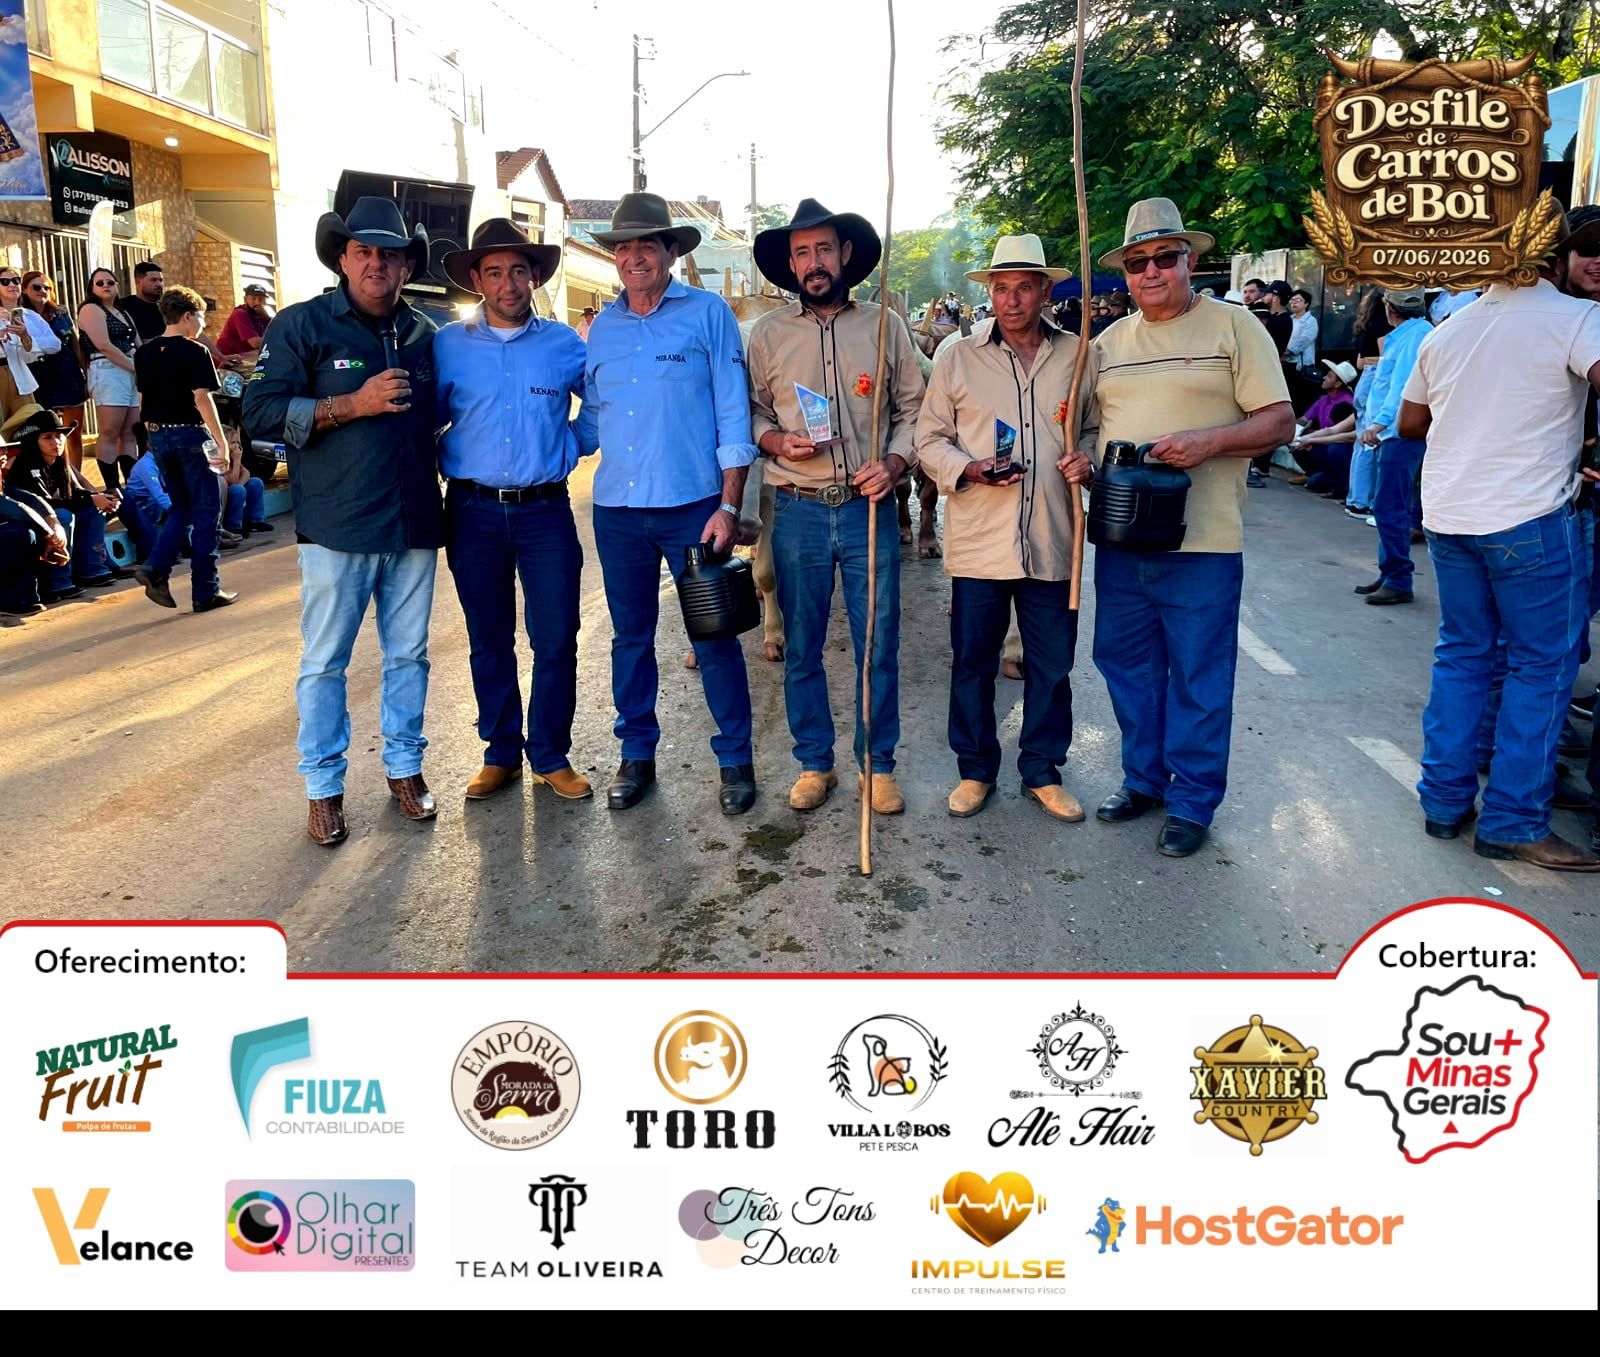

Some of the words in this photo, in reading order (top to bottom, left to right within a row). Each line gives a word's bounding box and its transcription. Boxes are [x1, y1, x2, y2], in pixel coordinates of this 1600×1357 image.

[67, 146, 130, 178] ALISSON
[655, 354, 686, 363] MIRANDA
[529, 386, 560, 398] RENATO
